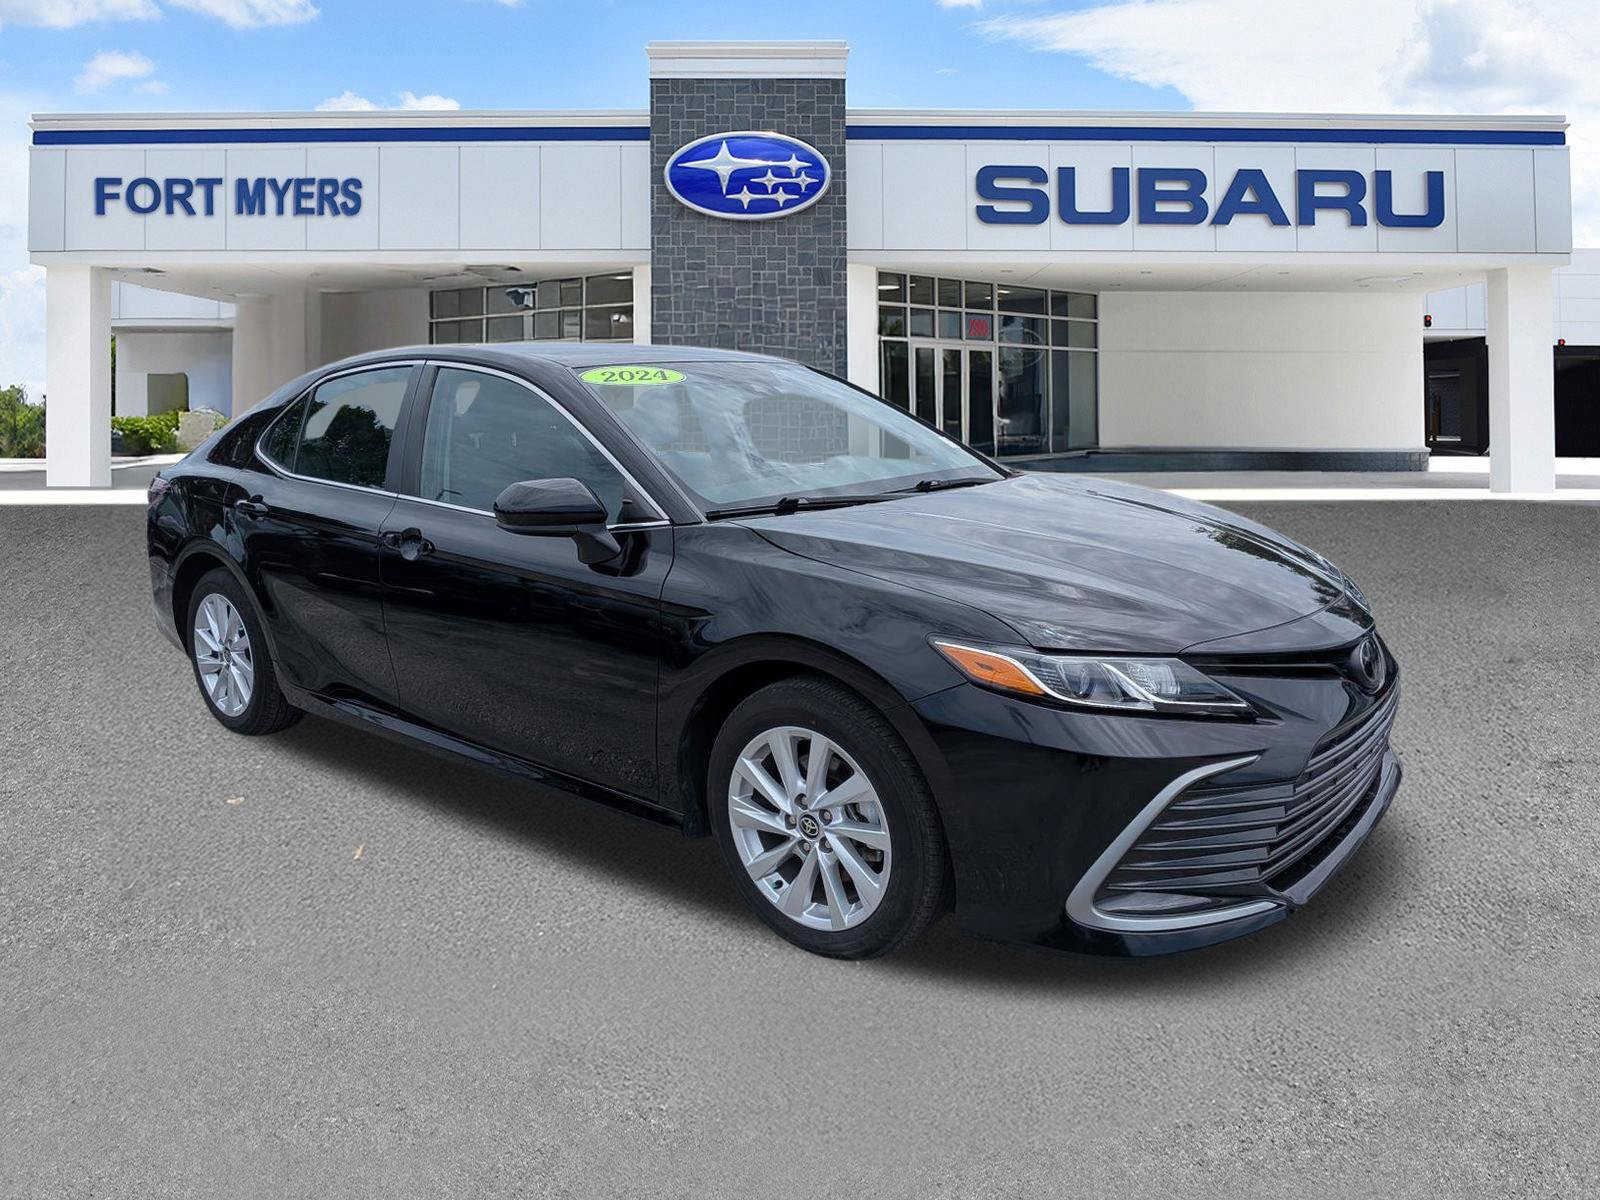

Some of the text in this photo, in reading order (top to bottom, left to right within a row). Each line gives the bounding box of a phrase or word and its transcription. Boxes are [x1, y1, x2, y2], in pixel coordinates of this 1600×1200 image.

[94, 177, 363, 217] FORT MYERS
[975, 165, 1446, 228] SUBARU
[600, 369, 669, 382] 2024
